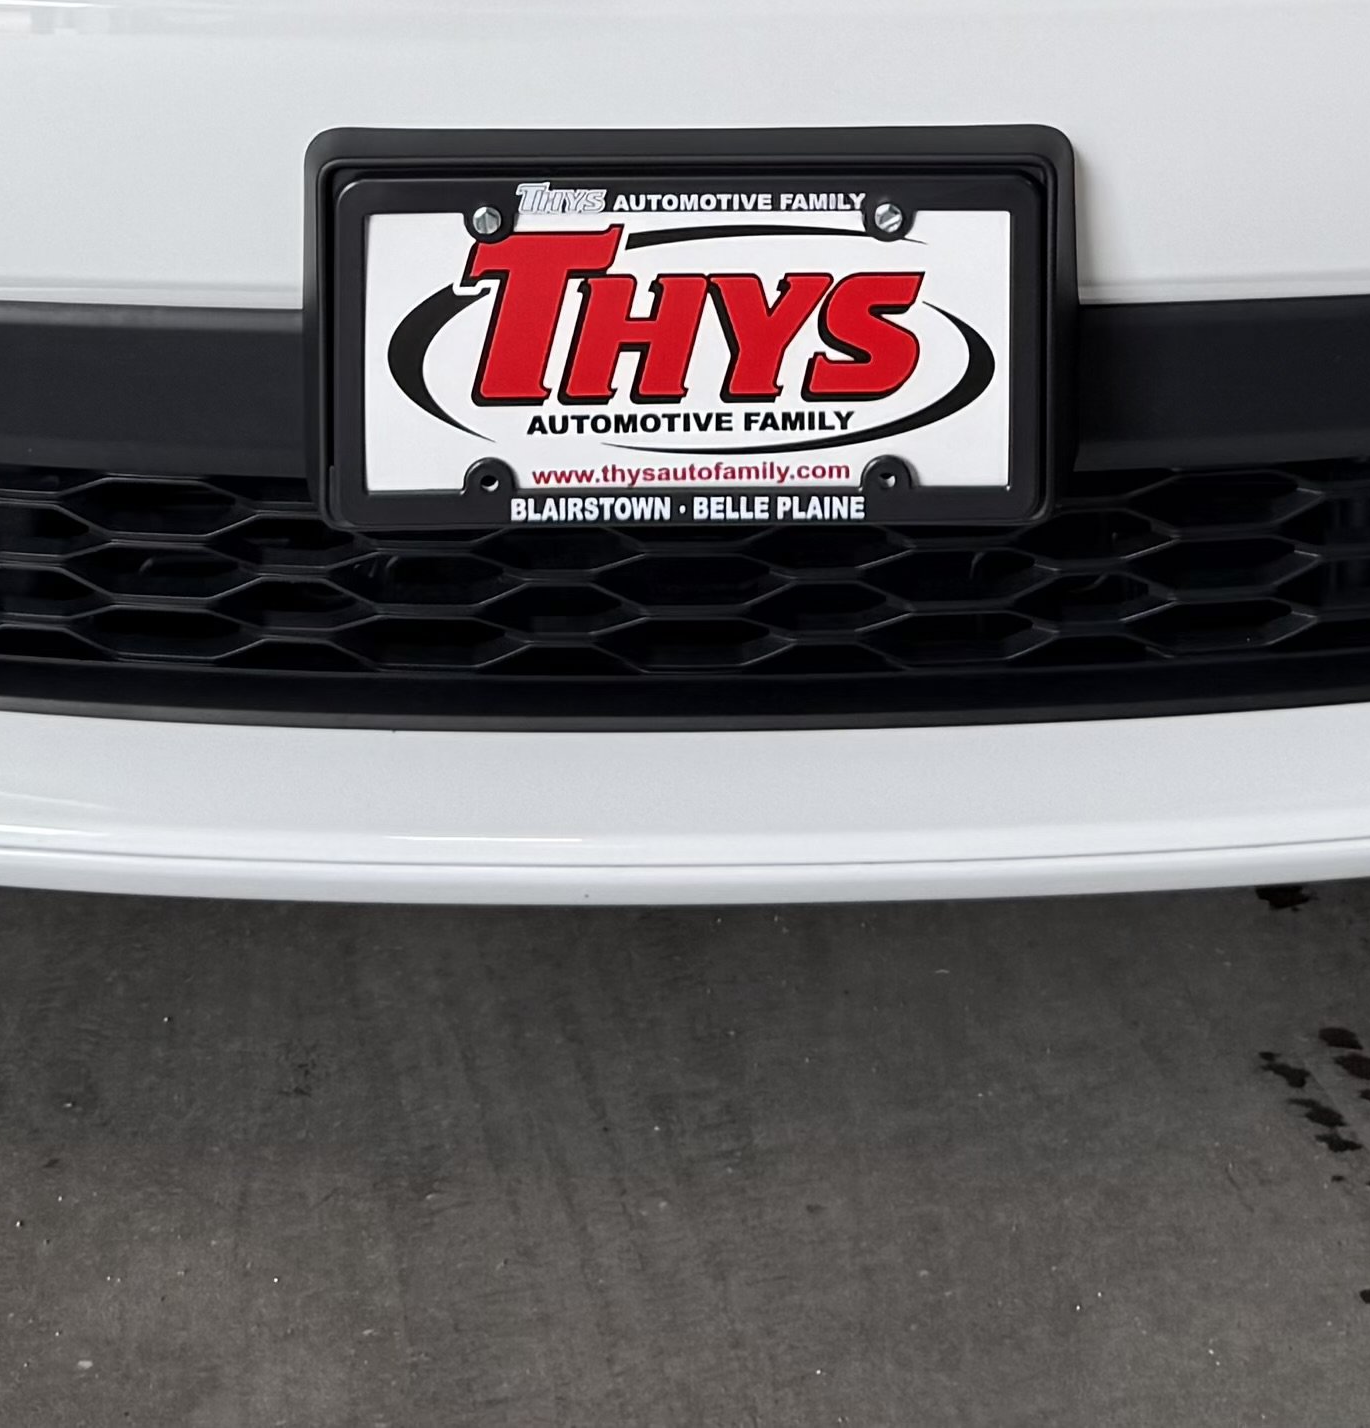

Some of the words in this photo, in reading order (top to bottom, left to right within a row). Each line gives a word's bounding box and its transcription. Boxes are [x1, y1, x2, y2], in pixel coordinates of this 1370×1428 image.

[516, 182, 607, 214] THYS
[613, 193, 772, 212] AUTOMOTIVE
[780, 193, 866, 211] FAMILY
[460, 224, 925, 405] THYS
[527, 412, 733, 435] AUTOMOTIVE
[744, 410, 856, 432] FAMILY
[532, 461, 851, 487] www.thysautofamily.com
[510, 497, 672, 522] BLAIRSTOWN
[693, 497, 770, 521] BELLE
[777, 496, 865, 520] PLAINE
